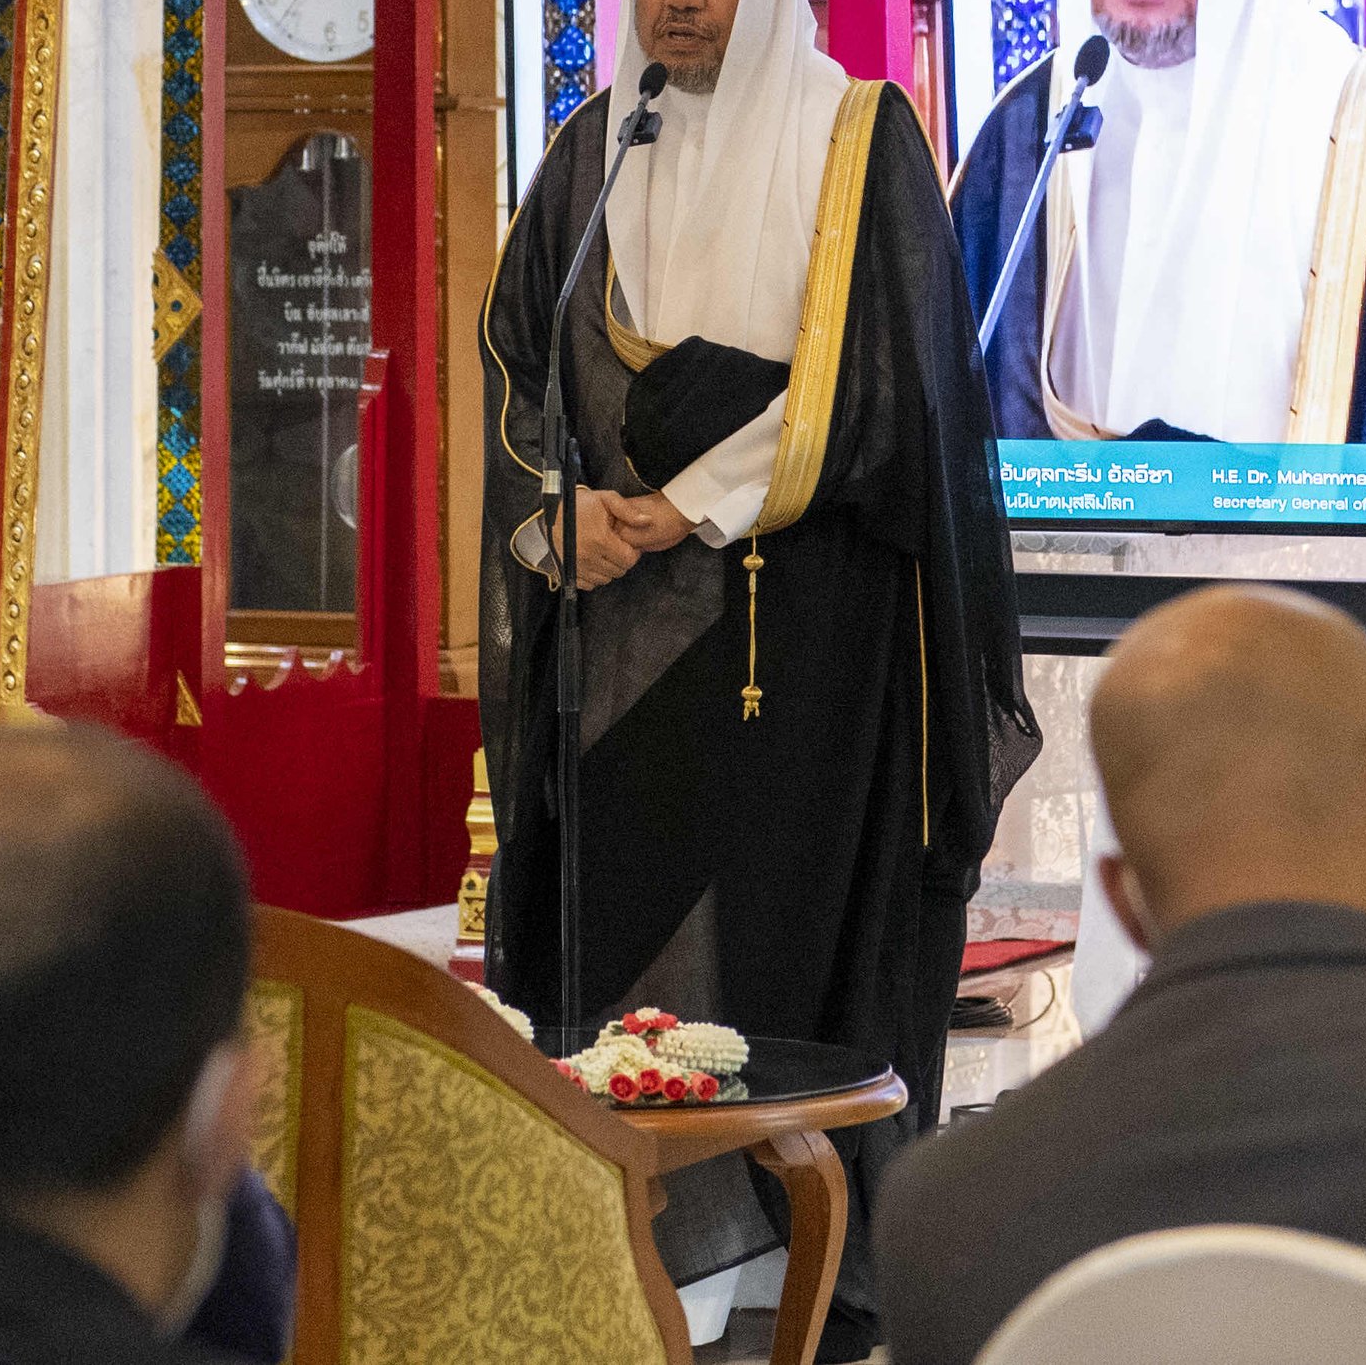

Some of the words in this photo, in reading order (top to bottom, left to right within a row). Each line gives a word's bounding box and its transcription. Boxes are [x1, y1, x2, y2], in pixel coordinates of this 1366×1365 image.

[1212, 469, 1243, 484] H.E.
[1247, 469, 1272, 484] Dr.
[1004, 491, 1134, 515] นนิบาตมุสลิมโลก
[1213, 495, 1287, 513] Secretary
[1292, 497, 1349, 511] General
